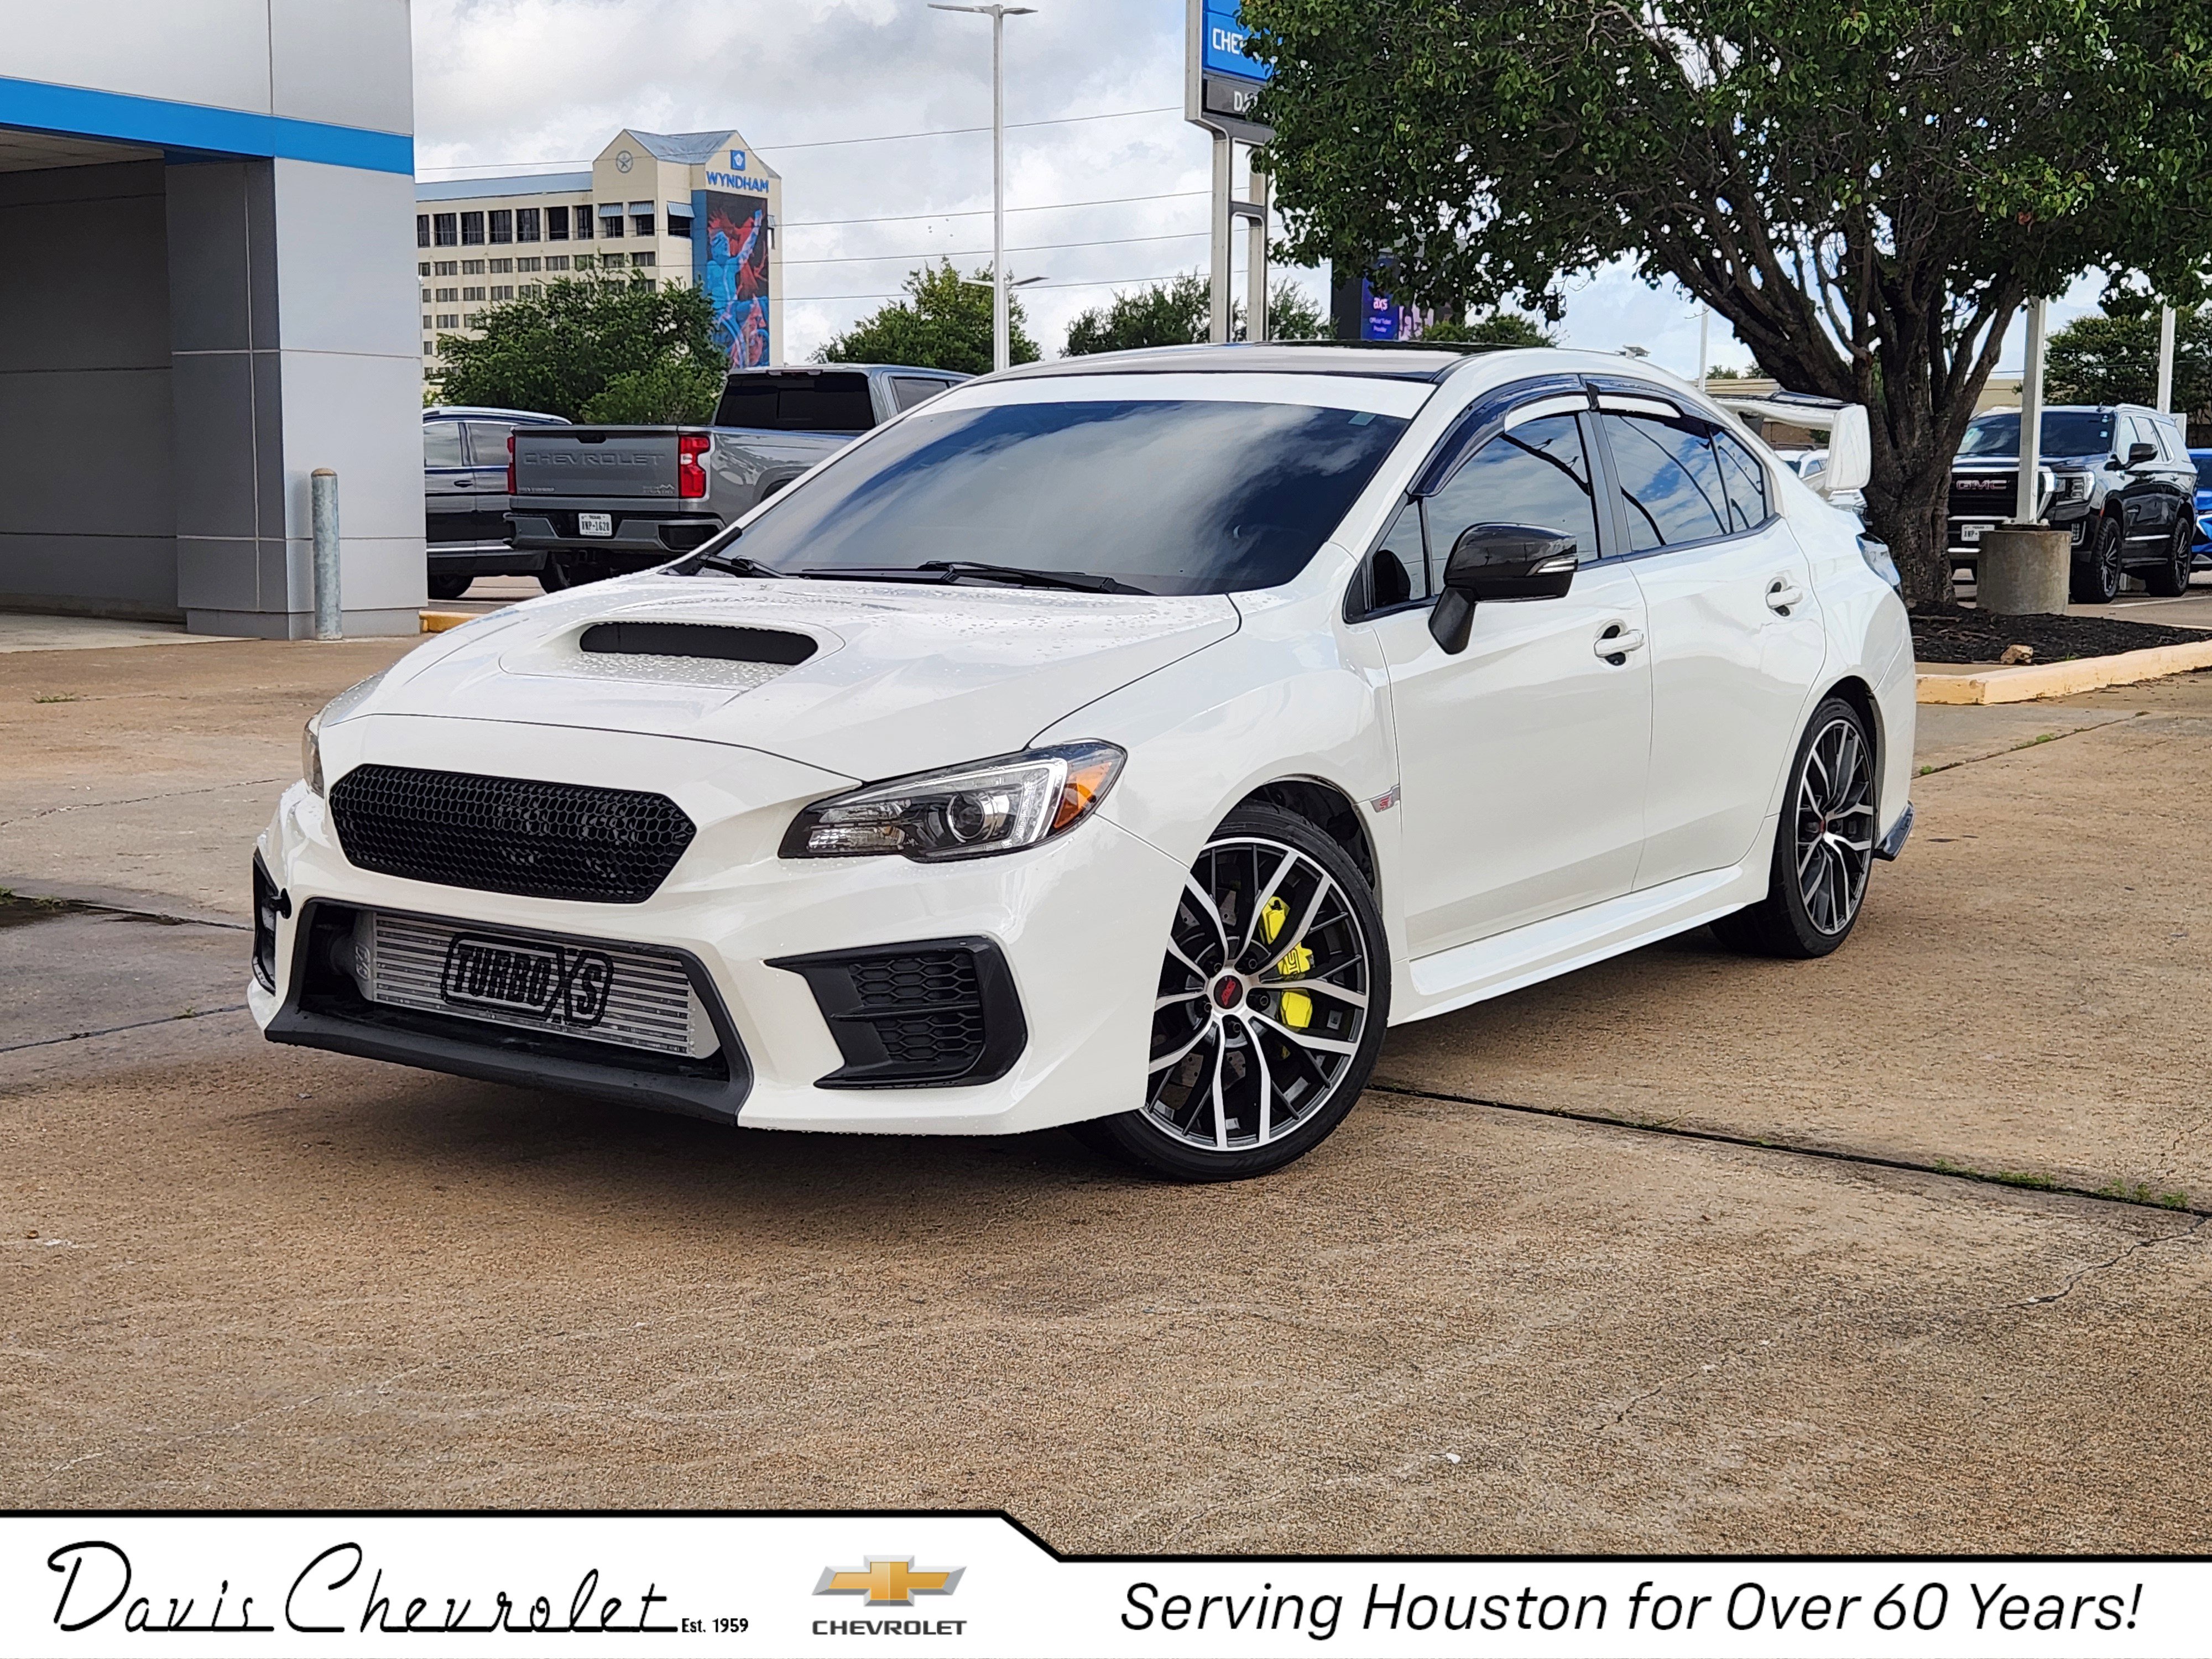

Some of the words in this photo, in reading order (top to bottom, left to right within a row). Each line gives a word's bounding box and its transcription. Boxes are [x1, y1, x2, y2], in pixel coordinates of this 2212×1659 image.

[706, 171, 769, 194] WYNDHAM
[524, 452, 665, 466] CHEVROLET
[1956, 479, 2007, 490] GMC
